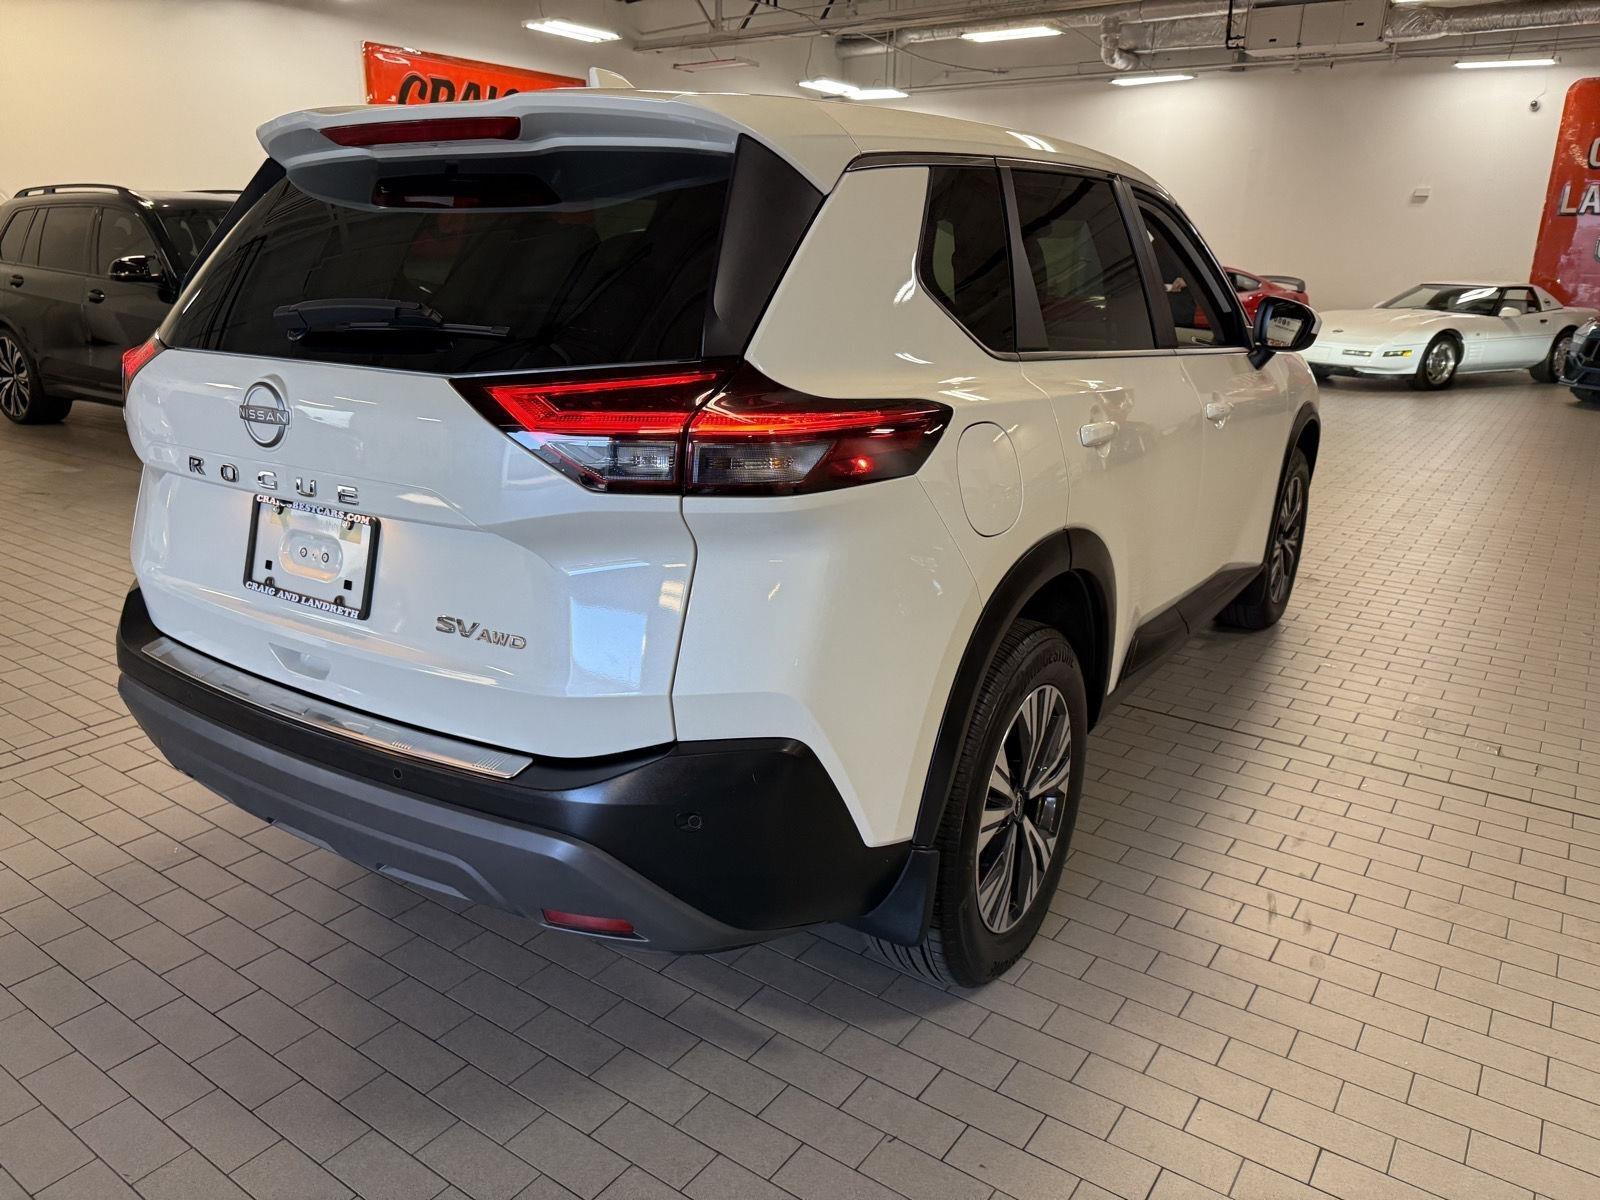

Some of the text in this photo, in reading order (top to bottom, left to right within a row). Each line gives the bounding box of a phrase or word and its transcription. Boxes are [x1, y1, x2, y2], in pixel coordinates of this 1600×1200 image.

[398, 73, 520, 105] CRAI
[240, 406, 289, 424] NISSAN
[188, 455, 360, 506] ROGUE
[245, 581, 360, 619] CRAIG AND LANDRETH
[436, 614, 527, 650] SV AWD
